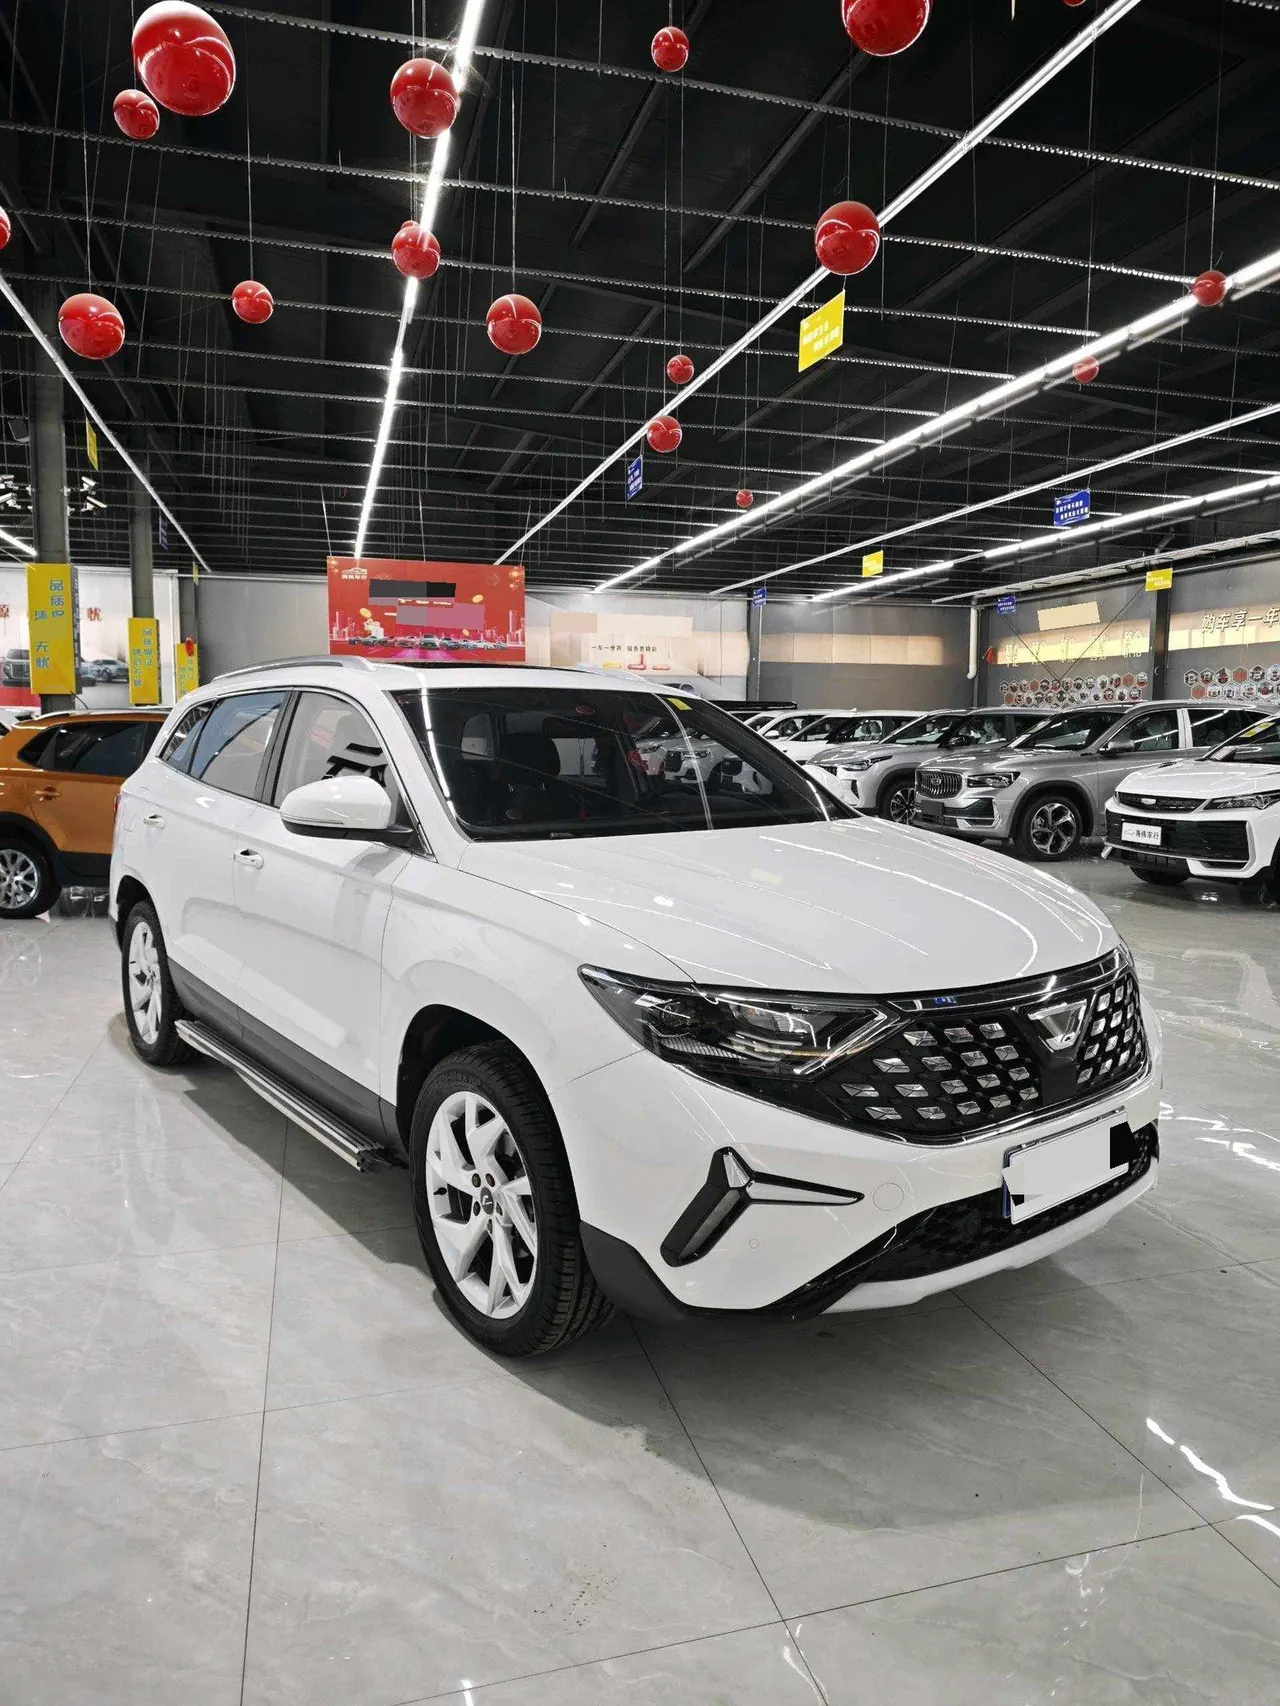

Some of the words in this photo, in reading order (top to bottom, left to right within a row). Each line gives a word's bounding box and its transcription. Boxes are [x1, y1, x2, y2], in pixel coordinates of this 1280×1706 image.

[1202, 606, 1280, 633] 购车享一年
